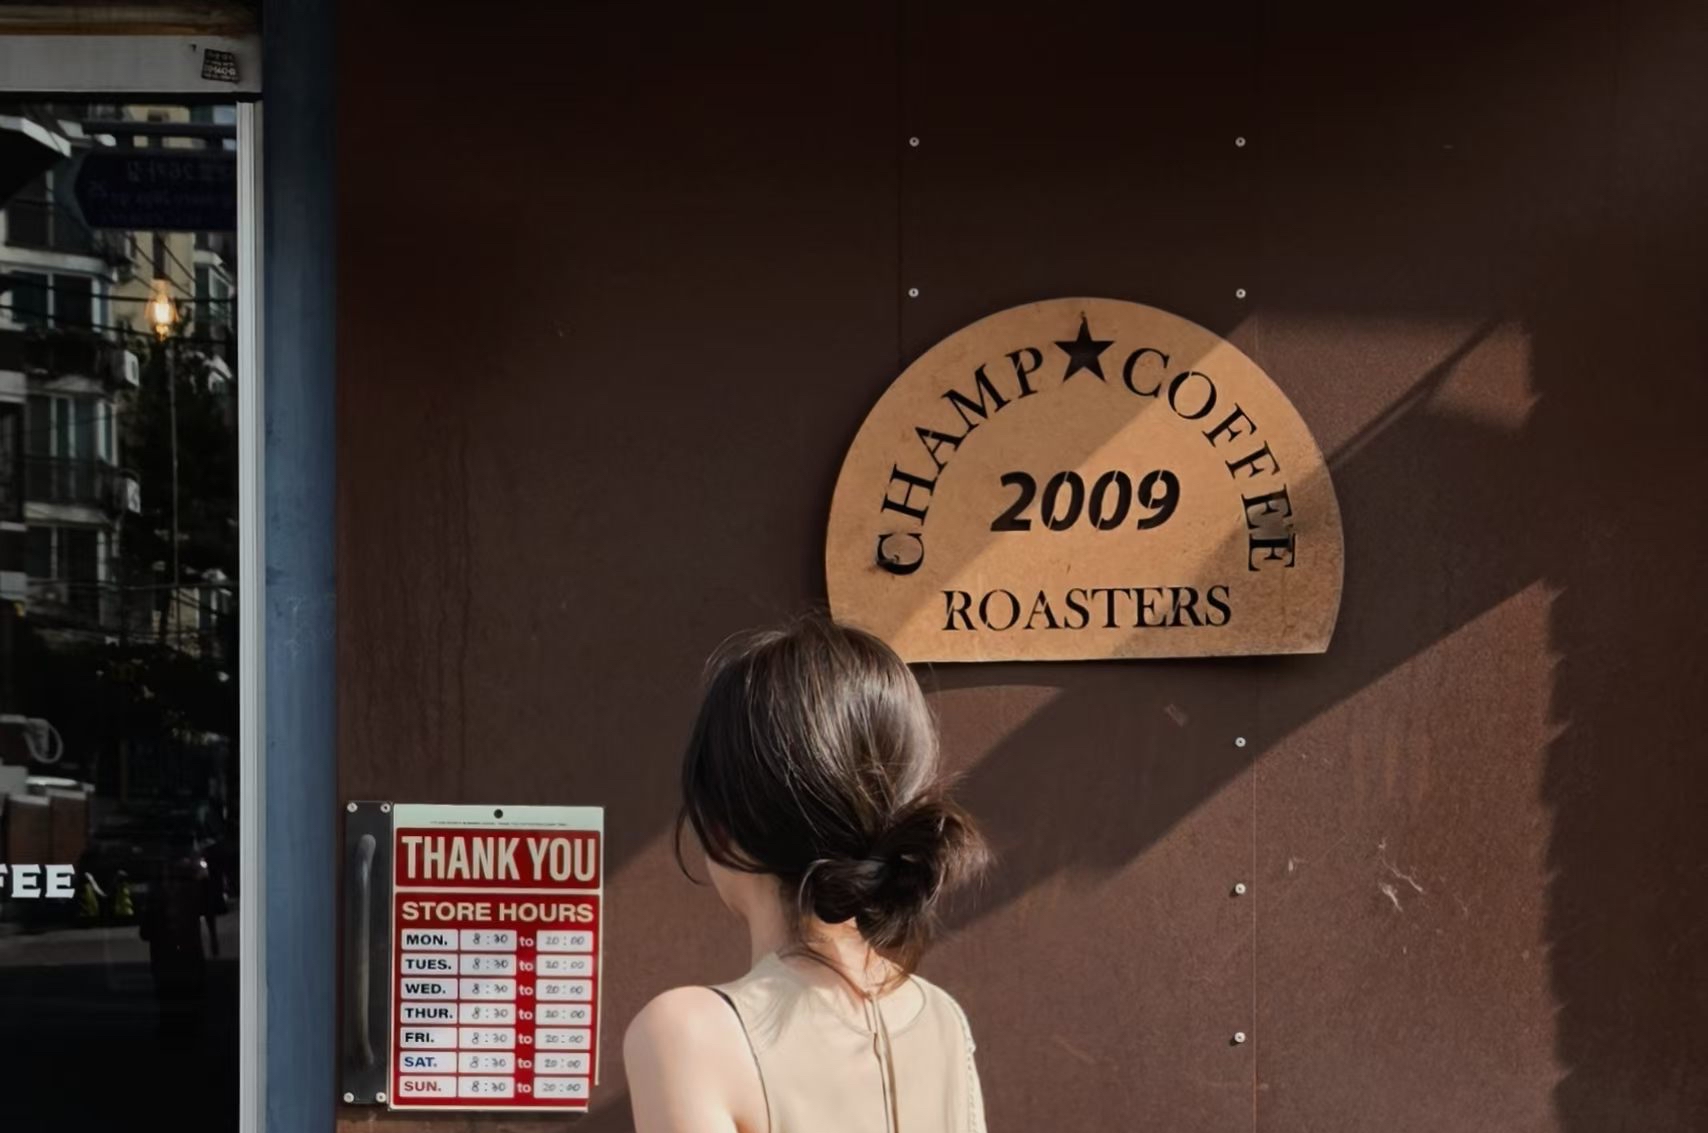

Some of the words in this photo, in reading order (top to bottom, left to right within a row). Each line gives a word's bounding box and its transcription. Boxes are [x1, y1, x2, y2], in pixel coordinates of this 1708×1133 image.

[876, 347, 1043, 576] CHAMP
[1122, 347, 1297, 571] COFFEE
[990, 469, 1181, 532] 2009
[942, 585, 1233, 631] ROASTERS
[401, 836, 520, 880] THANK
[526, 837, 596, 882] YOU
[402, 901, 492, 922] STORE
[499, 902, 594, 923] HOURS
[406, 934, 448, 946] MON.
[519, 936, 534, 947] to
[405, 959, 452, 970] TUES.
[519, 961, 533, 972] to
[405, 983, 446, 995] WED.
[519, 985, 533, 996] to
[404, 1008, 453, 1019] THUR.
[519, 1009, 533, 1020] to
[405, 1032, 435, 1043] FRI.
[518, 1034, 533, 1044] to
[404, 1056, 437, 1068] SAT.
[518, 1058, 532, 1069] to
[404, 1081, 441, 1092] SUN.
[517, 1083, 532, 1094] to
